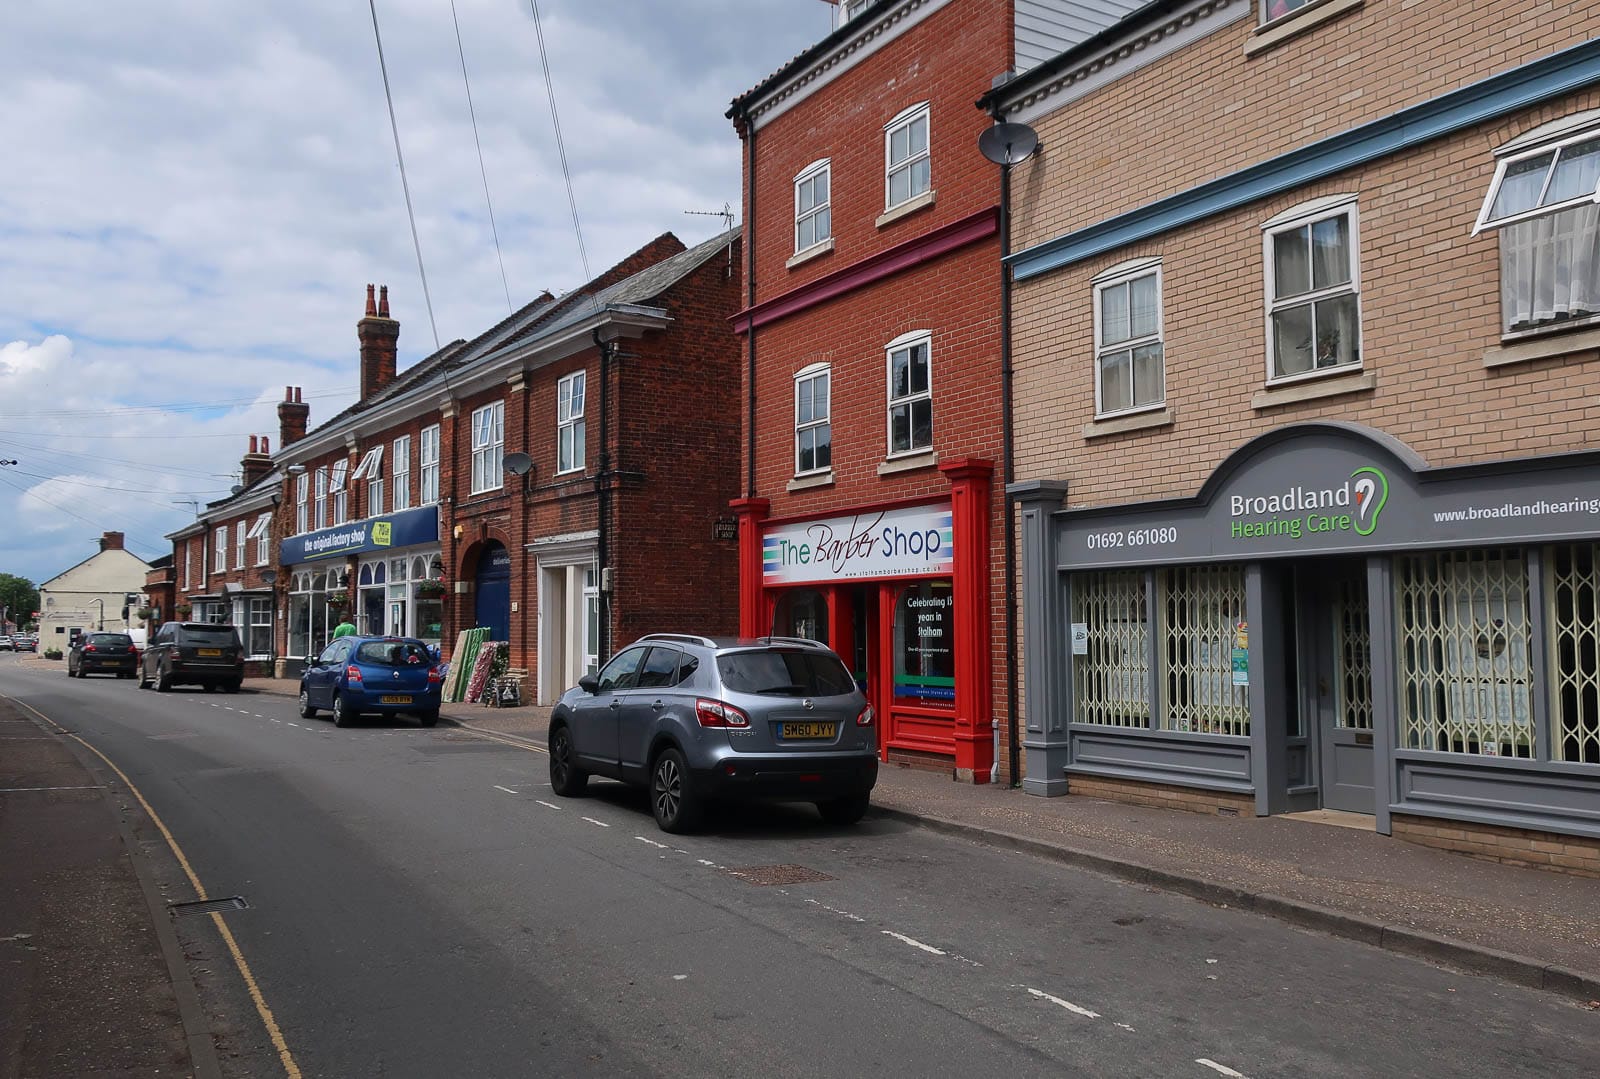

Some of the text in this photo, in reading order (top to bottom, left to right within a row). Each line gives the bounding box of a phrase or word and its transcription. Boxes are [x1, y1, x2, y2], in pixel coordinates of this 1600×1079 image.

[1231, 482, 1350, 517] Broadland
[1434, 497, 1600, 522] www.broadlandhearing
[1231, 514, 1350, 538] Hearing Care
[304, 539, 313, 552] the
[351, 529, 365, 544] shop
[780, 511, 941, 573] The Barber Shop
[1087, 527, 1177, 549] 01692 661080
[845, 566, 942, 577] www.stalhambarbershop.co.uk
[907, 597, 946, 609] Celebrating
[917, 611, 942, 624] years in
[918, 626, 943, 637] Stalham
[784, 724, 833, 736] SM60 JYY
